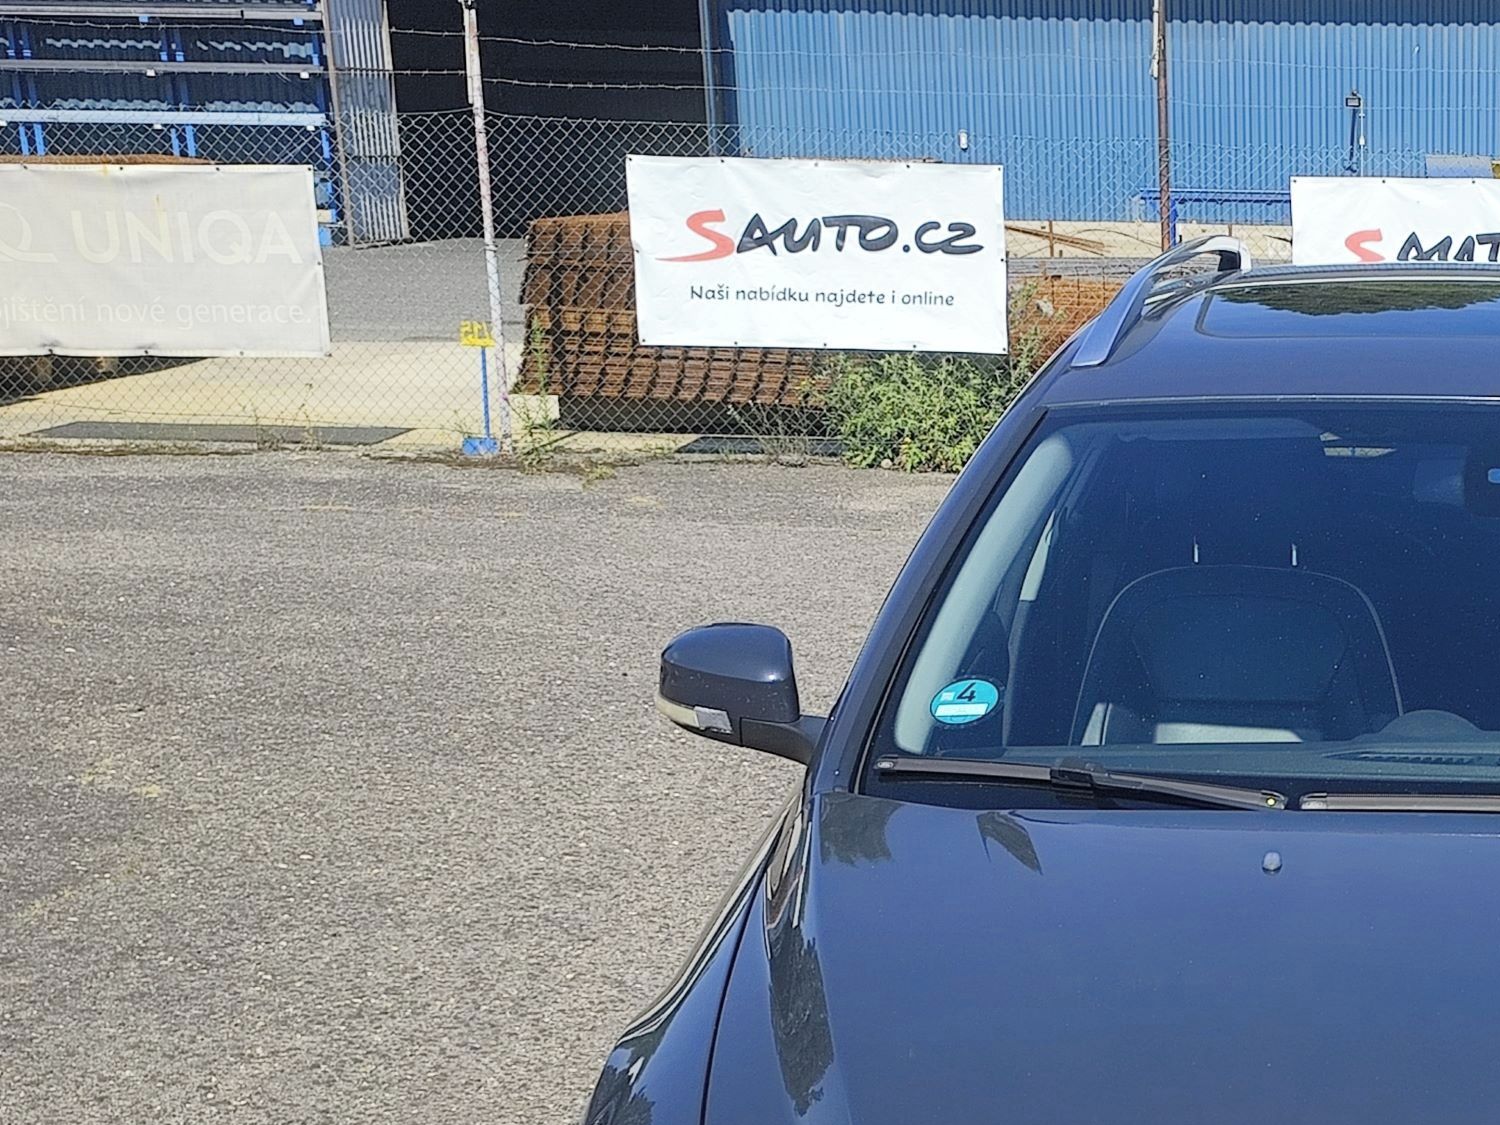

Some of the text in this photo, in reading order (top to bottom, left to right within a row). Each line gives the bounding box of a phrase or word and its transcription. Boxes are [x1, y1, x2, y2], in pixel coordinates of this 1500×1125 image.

[70, 209, 304, 265] UNIQA
[690, 283, 955, 307] Naši nabídku najdete i online
[96, 296, 166, 323] nové
[176, 301, 312, 331] generace.
[956, 682, 976, 701] 4
